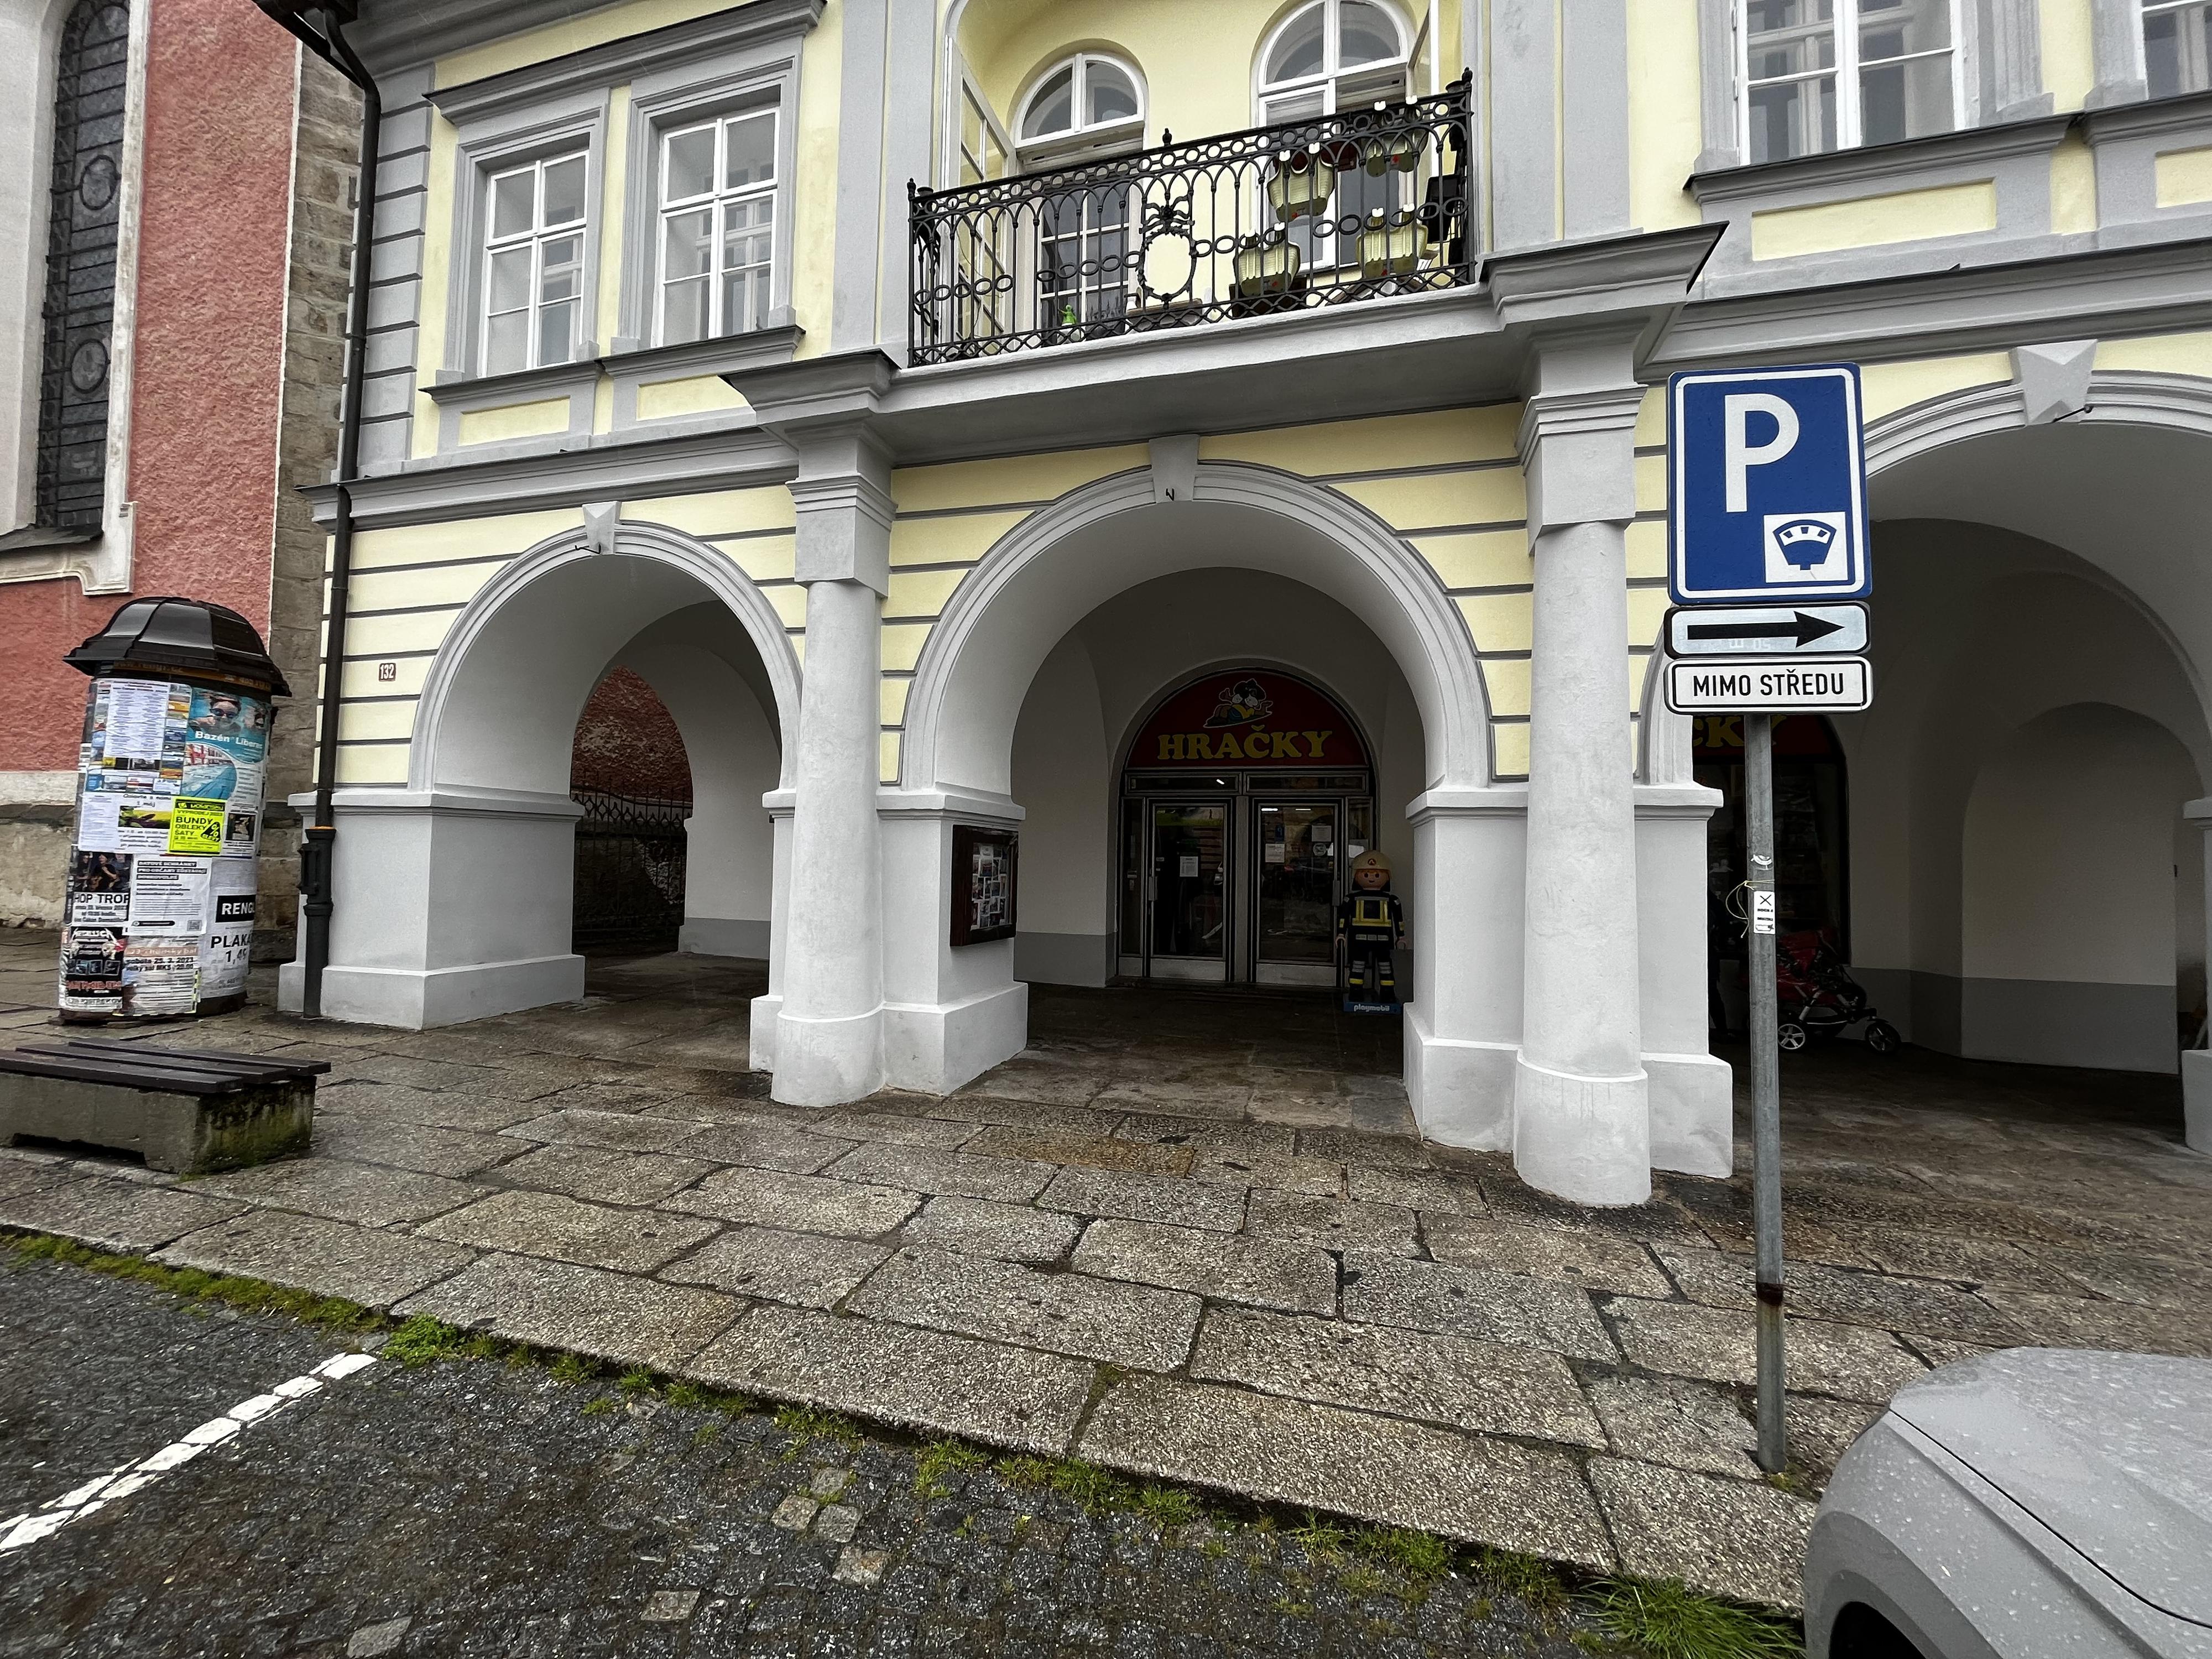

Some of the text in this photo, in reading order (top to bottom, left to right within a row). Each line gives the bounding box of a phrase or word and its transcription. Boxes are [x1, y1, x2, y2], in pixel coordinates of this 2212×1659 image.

[1725, 393, 1799, 513] P
[380, 664, 394, 680] 132
[1693, 669, 1844, 697] MIMO STŘEDU
[195, 730, 230, 742] Bazén
[1157, 724, 1333, 760] HRAČKY
[176, 816, 213, 825] BUNDY
